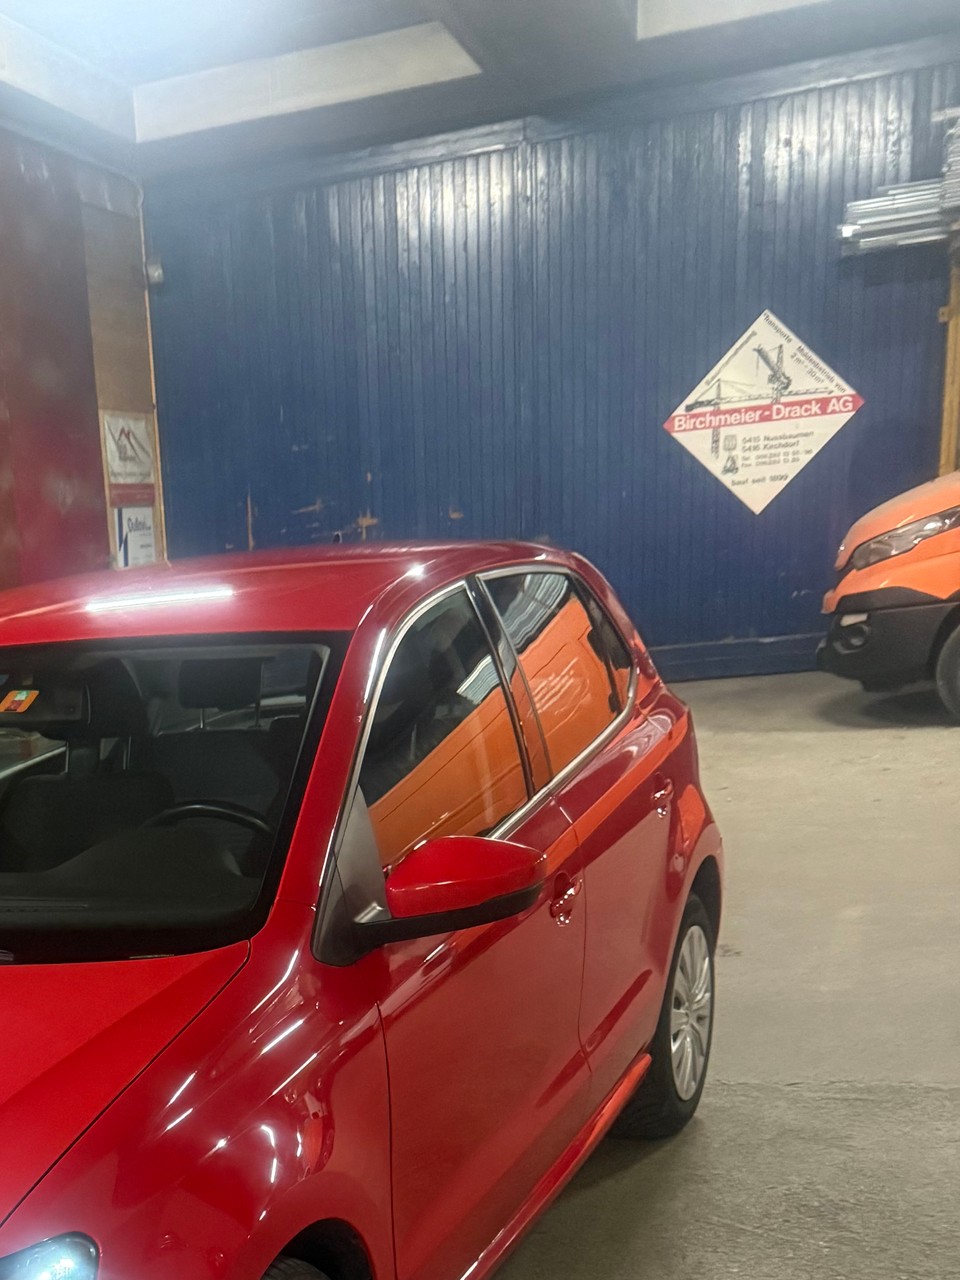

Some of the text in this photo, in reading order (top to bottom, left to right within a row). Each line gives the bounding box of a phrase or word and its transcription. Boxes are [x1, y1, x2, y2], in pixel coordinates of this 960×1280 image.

[763, 312, 793, 343] Transporte
[673, 396, 854, 432] Birchmeier-Drack AG
